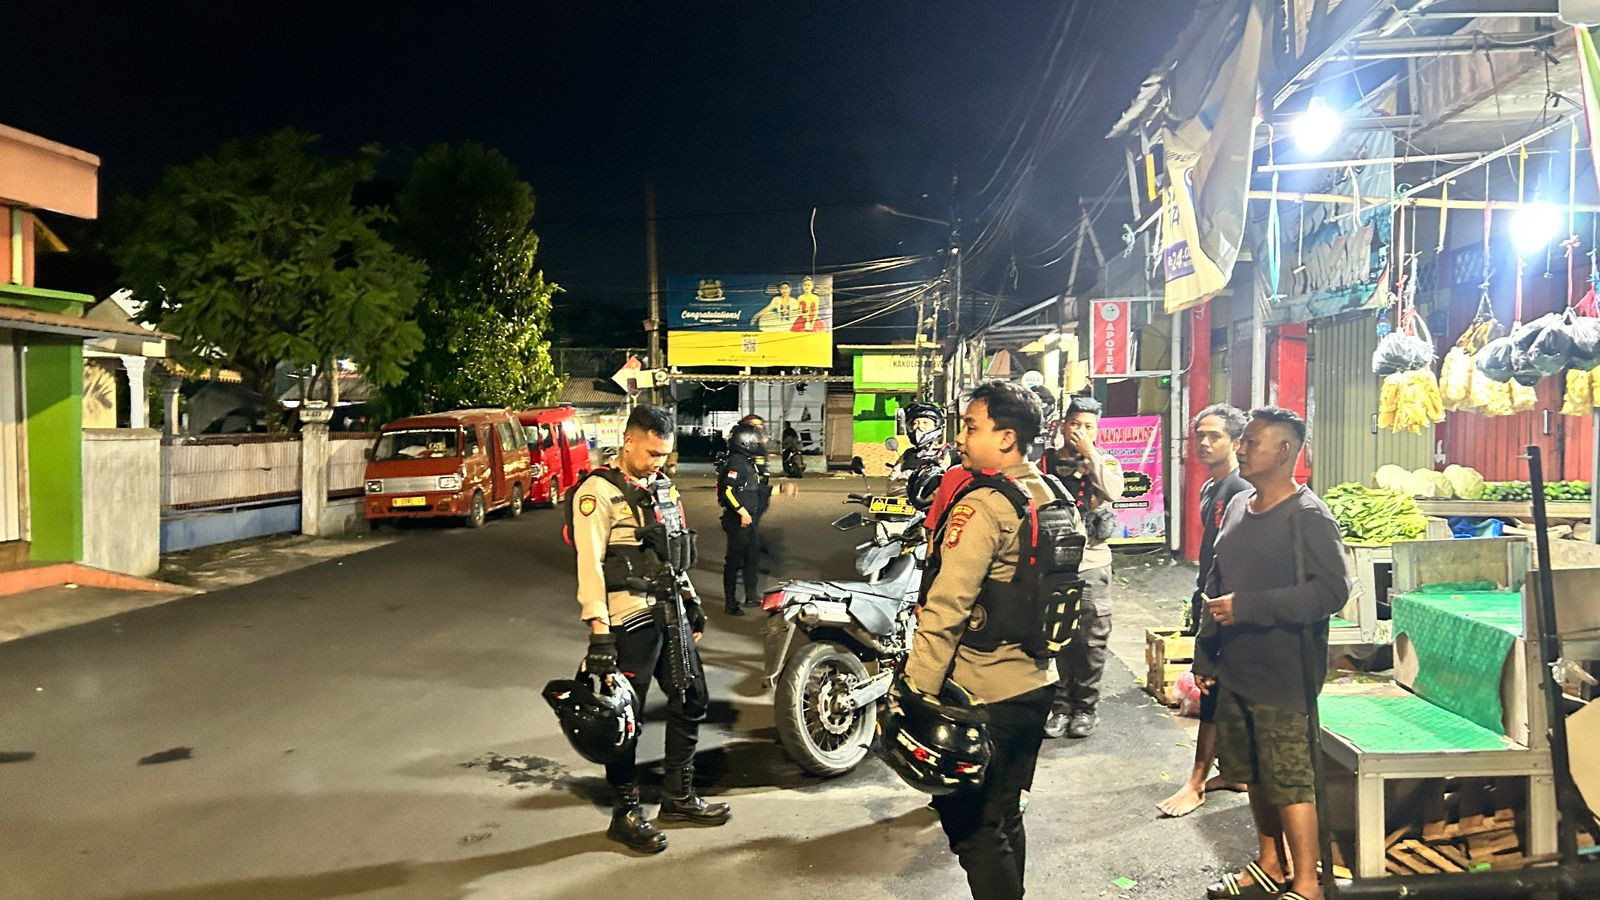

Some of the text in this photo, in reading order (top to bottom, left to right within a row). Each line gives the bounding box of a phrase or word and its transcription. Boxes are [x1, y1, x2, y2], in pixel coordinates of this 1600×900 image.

[681, 310, 742, 320] Congratulations!
[1104, 322, 1116, 373] APOTEK
[1100, 426, 1158, 443] NANDA LAUND
